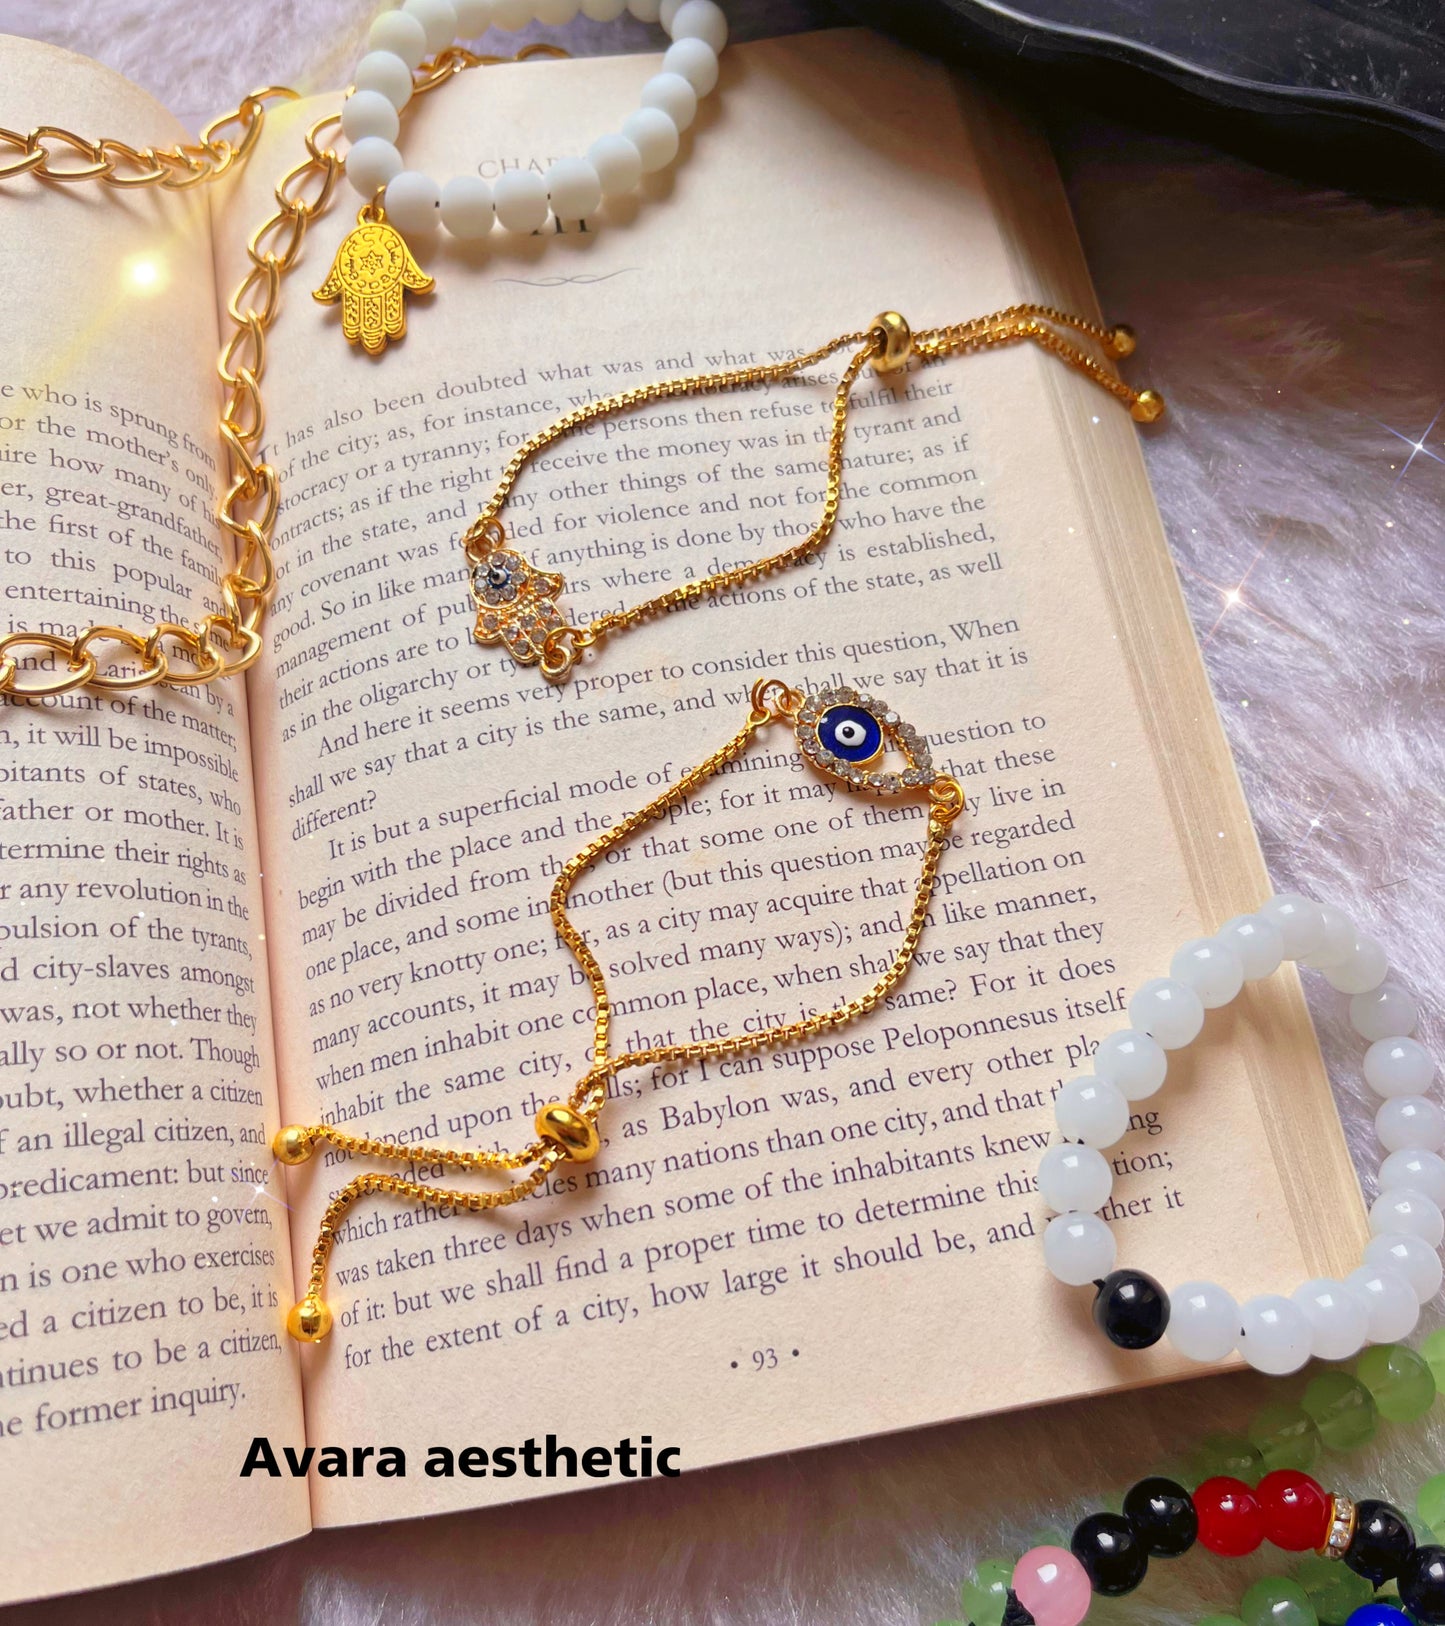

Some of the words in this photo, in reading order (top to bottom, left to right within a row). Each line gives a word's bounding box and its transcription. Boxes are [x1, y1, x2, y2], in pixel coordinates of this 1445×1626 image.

[22, 384, 77, 406] who
[85, 392, 102, 412] is
[110, 405, 178, 449] sprung
[324, 409, 363, 430] also
[373, 393, 424, 415] been
[436, 368, 527, 400] doubted
[538, 363, 590, 381] what
[705, 350, 754, 366] what
[36, 415, 76, 438] the
[338, 434, 377, 455] city;
[464, 400, 560, 424] instance,
[402, 440, 488, 472] tyranny;
[695, 407, 743, 424] then
[750, 401, 812, 419] refuse
[440, 466, 492, 492] right
[540, 450, 608, 471] receive
[658, 440, 731, 457] money
[853, 418, 914, 443] tyrant
[49, 448, 104, 475] how
[115, 468, 171, 502] many
[427, 499, 467, 524] and
[549, 480, 608, 501] other
[619, 472, 687, 493] things
[49, 514, 98, 539] first
[142, 534, 173, 560] the
[301, 554, 389, 597] covenant
[596, 503, 690, 525] violence
[879, 469, 977, 495] common
[377, 579, 415, 601] like
[547, 538, 647, 567] anything
[676, 529, 732, 548] done
[891, 506, 944, 523] have
[51, 548, 96, 572] this
[113, 563, 192, 600] popular
[276, 618, 392, 679] management
[867, 522, 995, 558] established,
[5, 585, 156, 624] entertaining
[279, 678, 314, 709] their
[319, 654, 389, 689] actions
[866, 572, 923, 590] state,
[956, 552, 1003, 576] well
[318, 724, 359, 758] And
[364, 716, 411, 740] here
[441, 693, 510, 720] seems
[590, 669, 653, 694] proper
[692, 649, 788, 676] consider
[795, 642, 836, 663] this
[843, 631, 946, 663] question,
[948, 619, 1020, 642] When
[322, 699, 352, 721] the
[359, 668, 458, 707] oligarchy
[364, 754, 396, 776] say
[404, 740, 449, 763] that
[477, 724, 517, 747] city
[599, 703, 666, 723] same,
[893, 668, 927, 687] say
[935, 657, 981, 678] that
[53, 725, 101, 747] will
[144, 733, 238, 782] impossible
[124, 809, 209, 837] mother.
[138, 774, 202, 805] states,
[209, 789, 241, 815] who
[292, 790, 377, 841] different?
[438, 781, 561, 828] superficial
[569, 770, 638, 799] mode
[298, 877, 345, 910] begin
[350, 857, 398, 887] with
[450, 834, 512, 868] place
[940, 758, 987, 780] that
[994, 749, 1056, 771] these
[114, 839, 170, 865] their
[177, 848, 229, 878] rights
[375, 875, 460, 917] divided
[469, 867, 531, 893] from
[642, 836, 691, 858] that
[700, 827, 765, 849] some
[20, 883, 69, 906] any
[76, 878, 202, 907] revolution
[341, 938, 400, 975] place,
[456, 906, 520, 933] some
[663, 869, 713, 898] (but
[719, 858, 763, 883] this
[770, 846, 874, 882] question
[970, 809, 1076, 849] regarded
[192, 927, 252, 961] tyrants,
[368, 995, 475, 1034] accounts,
[508, 974, 560, 998] may
[609, 942, 691, 978] solved
[699, 938, 766, 962] many
[774, 920, 852, 952] ways);
[942, 901, 987, 924] like
[994, 887, 1096, 916] manner,
[409, 952, 486, 983] knotty
[766, 884, 854, 916] acquire
[33, 954, 170, 986] city-slaves
[180, 966, 255, 997] amongst
[127, 995, 222, 1023] whether
[316, 1062, 365, 1090] when
[370, 1047, 418, 1073] men
[425, 1019, 510, 1058] inhabit
[694, 976, 768, 1010] place,
[772, 963, 843, 988] when
[1053, 921, 1104, 944] they
[444, 1066, 506, 1094] same
[519, 1051, 572, 1078] city,
[1059, 958, 1116, 981] does
[881, 1008, 1058, 1051] Peloponnesus
[1066, 987, 1127, 1020] itself
[135, 1042, 183, 1059] not.
[189, 1037, 260, 1074] Though
[73, 1076, 184, 1104] whether
[210, 1078, 263, 1106] citizen
[659, 1094, 770, 1131] Babylon
[780, 1087, 838, 1108] was,
[908, 1062, 974, 1087] every
[987, 1046, 1054, 1074] other
[64, 1118, 145, 1153] illegal
[154, 1117, 234, 1147] citizen,
[663, 1141, 759, 1173] nations
[766, 1128, 825, 1153] than
[884, 1107, 938, 1136] city,
[994, 1089, 1046, 1113] that
[87, 1204, 168, 1235] admit
[206, 1208, 272, 1234] govern,
[376, 1248, 436, 1276] taken
[443, 1233, 506, 1261] three
[580, 1203, 655, 1232] when
[664, 1188, 735, 1216] some
[832, 1146, 975, 1185] inhabitants
[981, 1131, 1051, 1158] knew
[125, 1247, 186, 1276] who
[194, 1242, 275, 1270] exercises
[486, 1261, 544, 1296] shall
[644, 1231, 735, 1274] proper
[747, 1218, 806, 1244] time
[855, 1184, 986, 1224] determine
[71, 1298, 167, 1330] citizen
[212, 1286, 246, 1315] be,
[426, 1320, 502, 1352] extent
[583, 1293, 639, 1324] city,
[649, 1281, 709, 1308] how
[722, 1267, 789, 1296] large
[833, 1233, 924, 1273] should
[220, 1327, 282, 1356] citizen,
[35, 1398, 142, 1432] former
[151, 1377, 246, 1417] inquiry.
